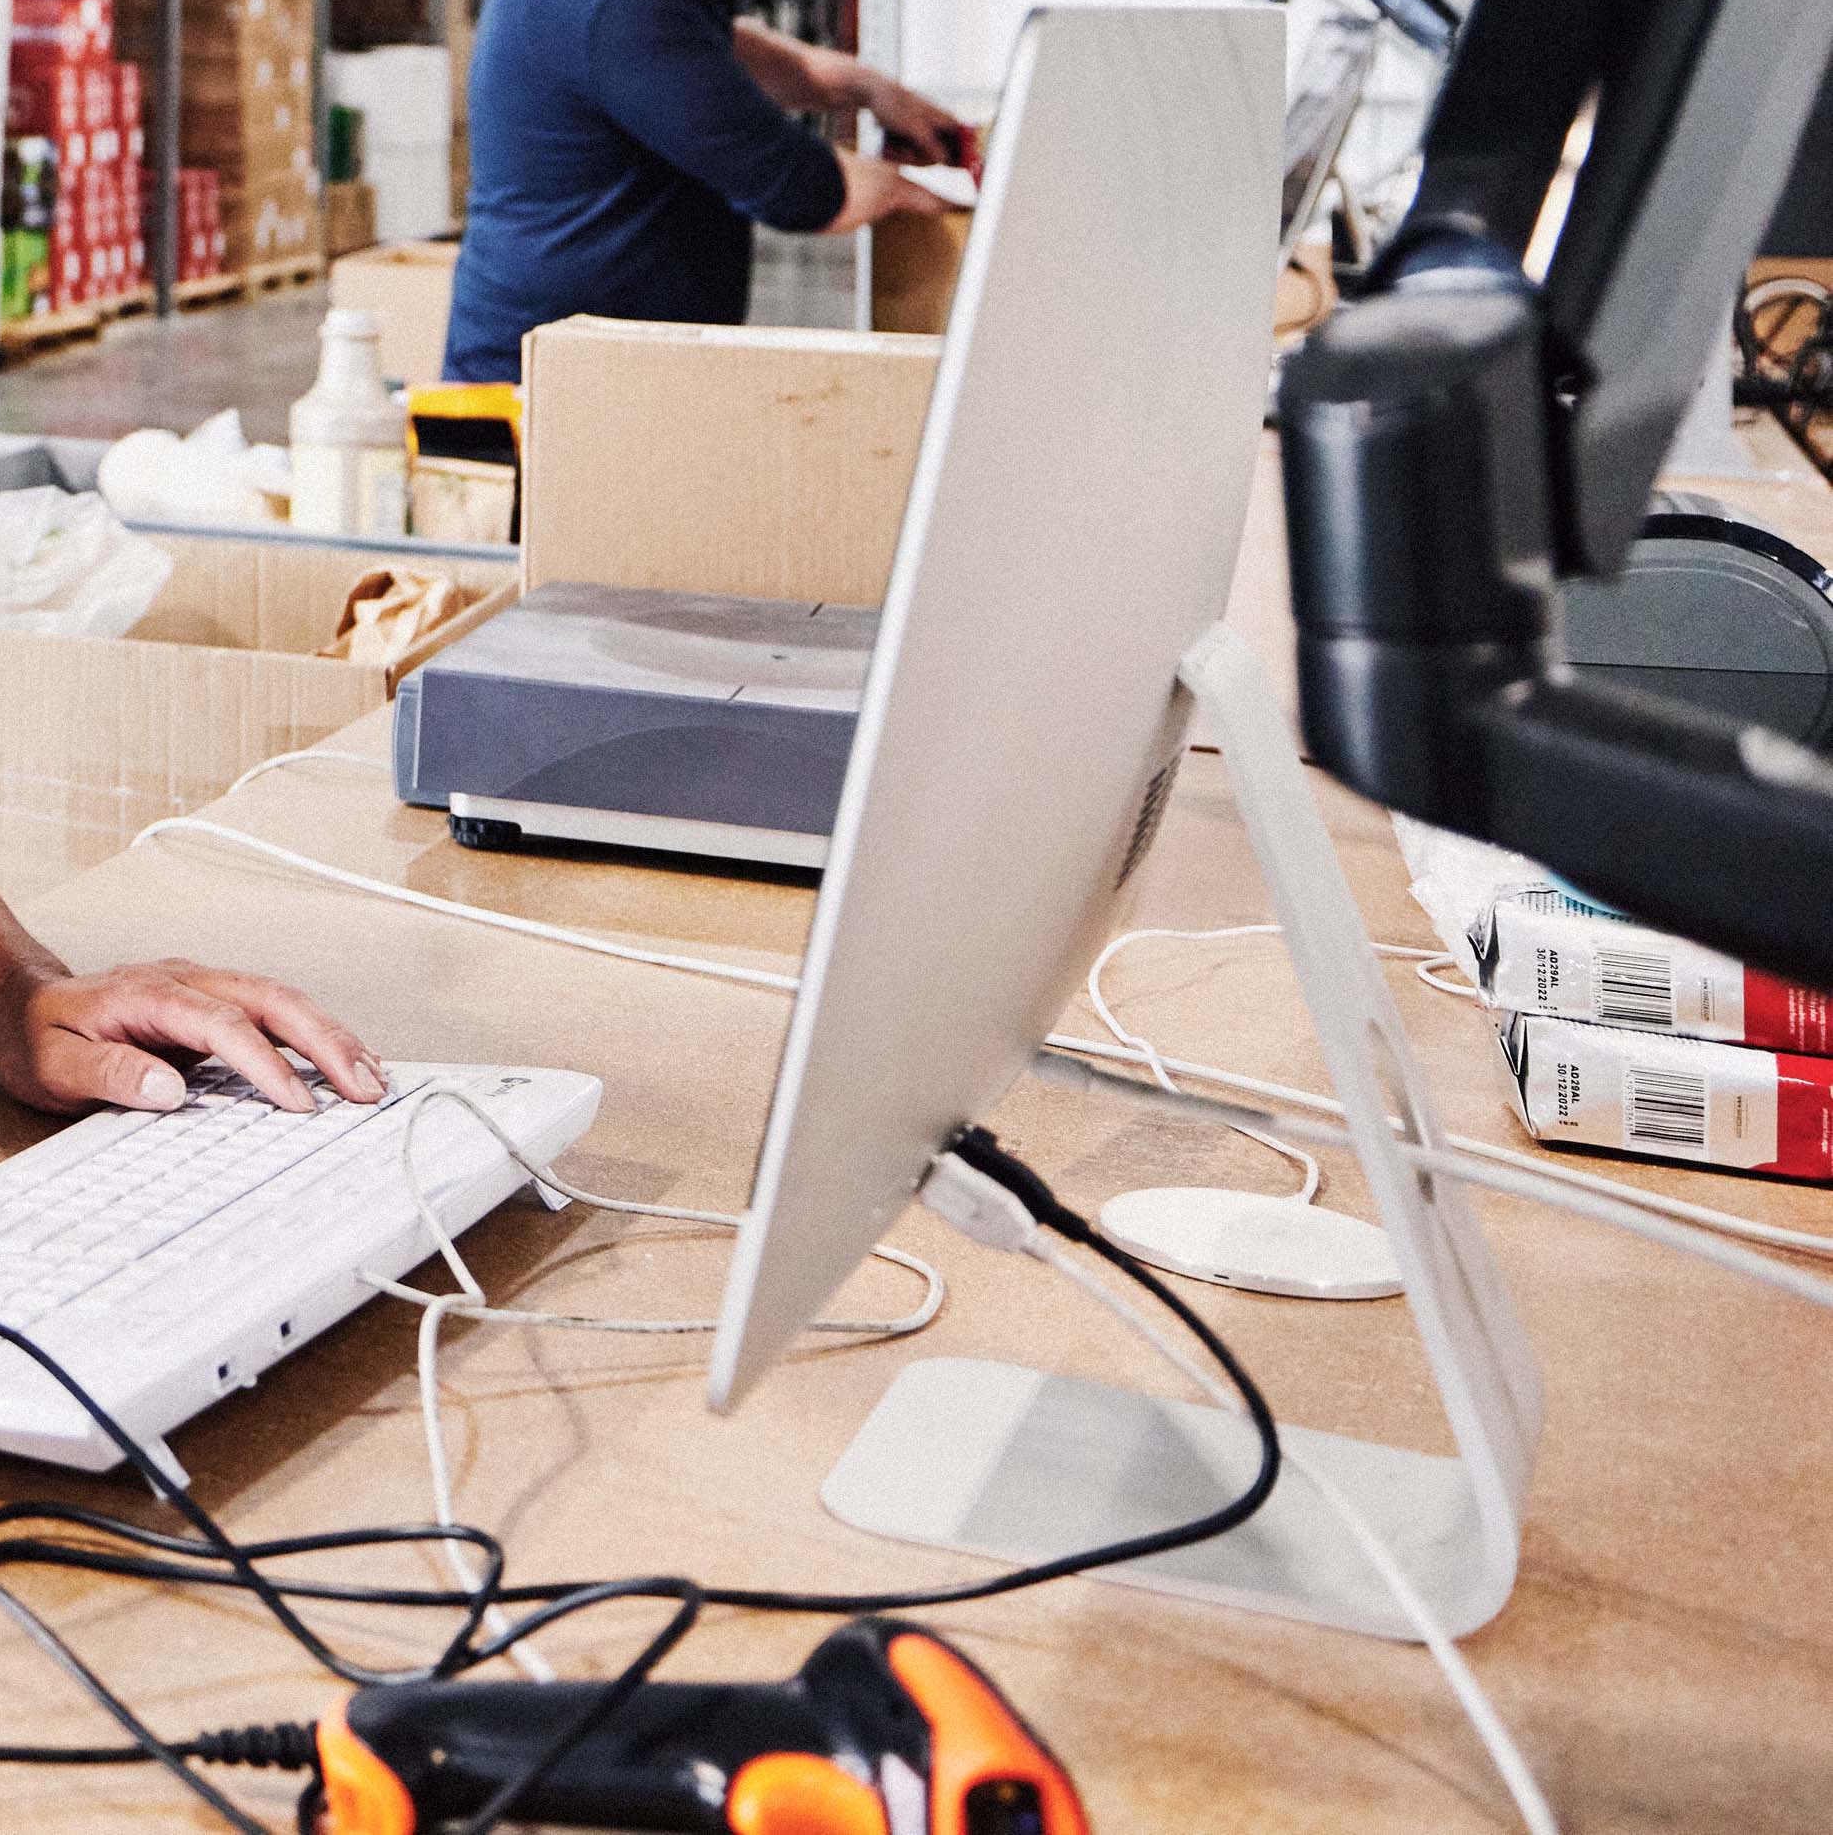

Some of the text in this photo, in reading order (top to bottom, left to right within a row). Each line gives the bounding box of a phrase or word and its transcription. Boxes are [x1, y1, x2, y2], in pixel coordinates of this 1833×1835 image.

[1536, 948, 1547, 1001] 30/12/2022
[1549, 949, 1559, 988] AD29AL
[1557, 1063, 1568, 1117] 30/12/2022
[1570, 1064, 1580, 1104] AD29AL
